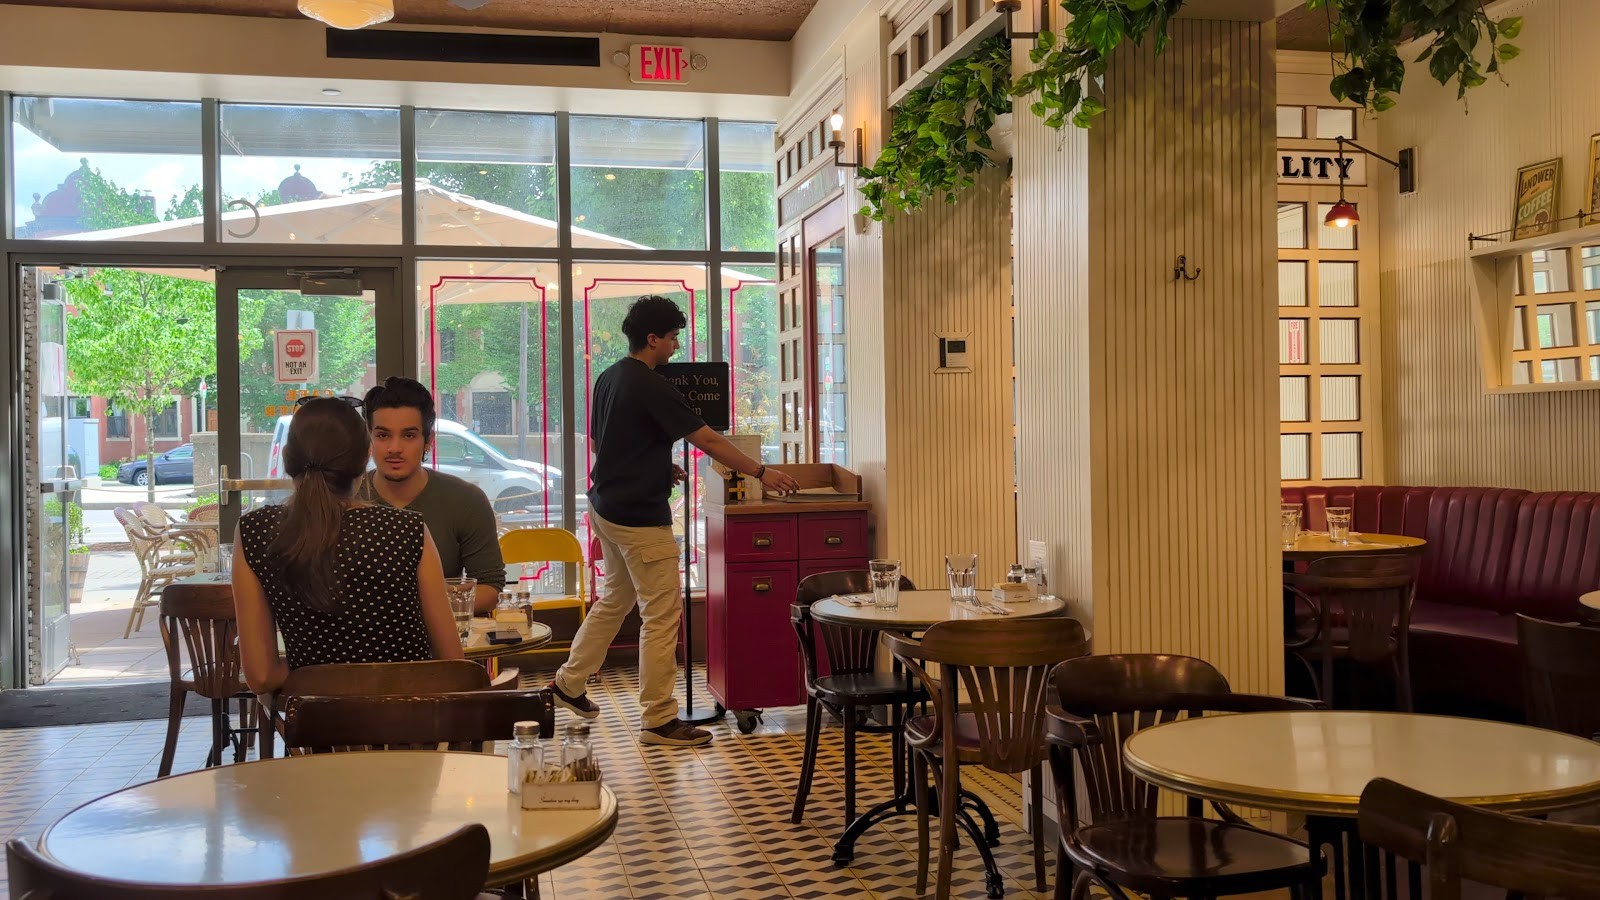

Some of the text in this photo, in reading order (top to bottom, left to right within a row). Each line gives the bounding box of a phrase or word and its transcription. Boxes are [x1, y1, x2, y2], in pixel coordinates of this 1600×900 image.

[641, 46, 682, 80] EXIT
[1277, 156, 1354, 180] LITY
[1520, 168, 1554, 198] LANDWER
[1518, 188, 1552, 221] COFFEE
[286, 344, 304, 353] STOP
[285, 361, 307, 369] NOT AN
[290, 367, 303, 375] EXIT
[692, 374, 719, 387] You,
[688, 390, 721, 401] Come
